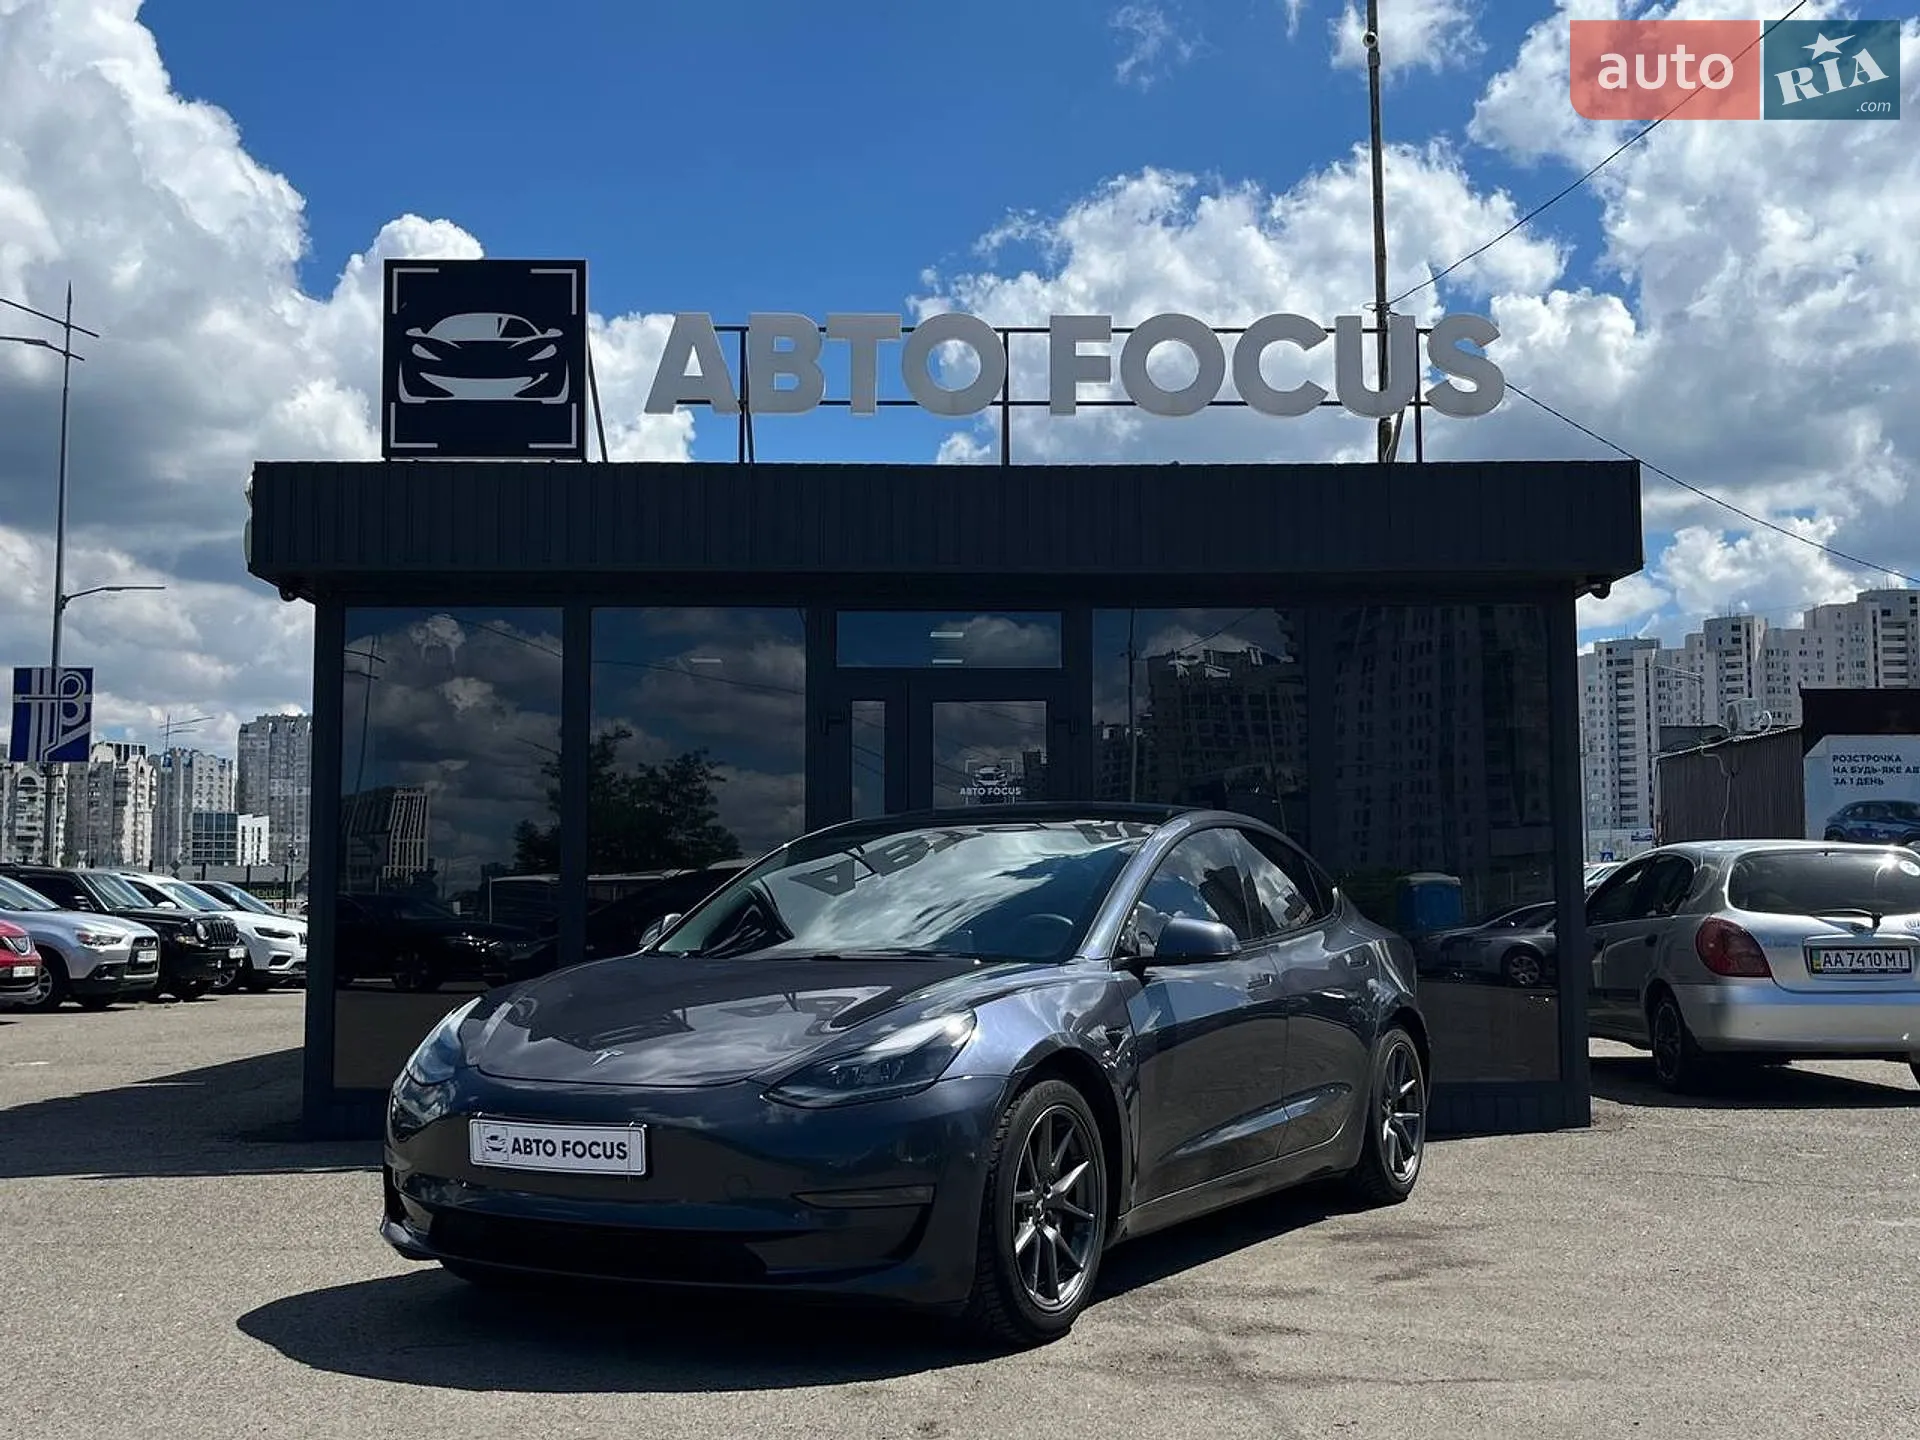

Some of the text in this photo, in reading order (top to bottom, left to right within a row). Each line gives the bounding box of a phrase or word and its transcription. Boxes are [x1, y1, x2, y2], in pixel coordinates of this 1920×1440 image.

[643, 312, 1506, 418] АВТО FOCUS
[1832, 754, 1902, 763] РОЗСТРОЧКА
[1832, 766, 1848, 774] НА
[1833, 777, 1847, 785] ЗА
[1856, 777, 1884, 786] ДЕНЬ
[959, 787, 1022, 796] АВТО FOCUS
[511, 1137, 628, 1161] АВТО FOCUS
